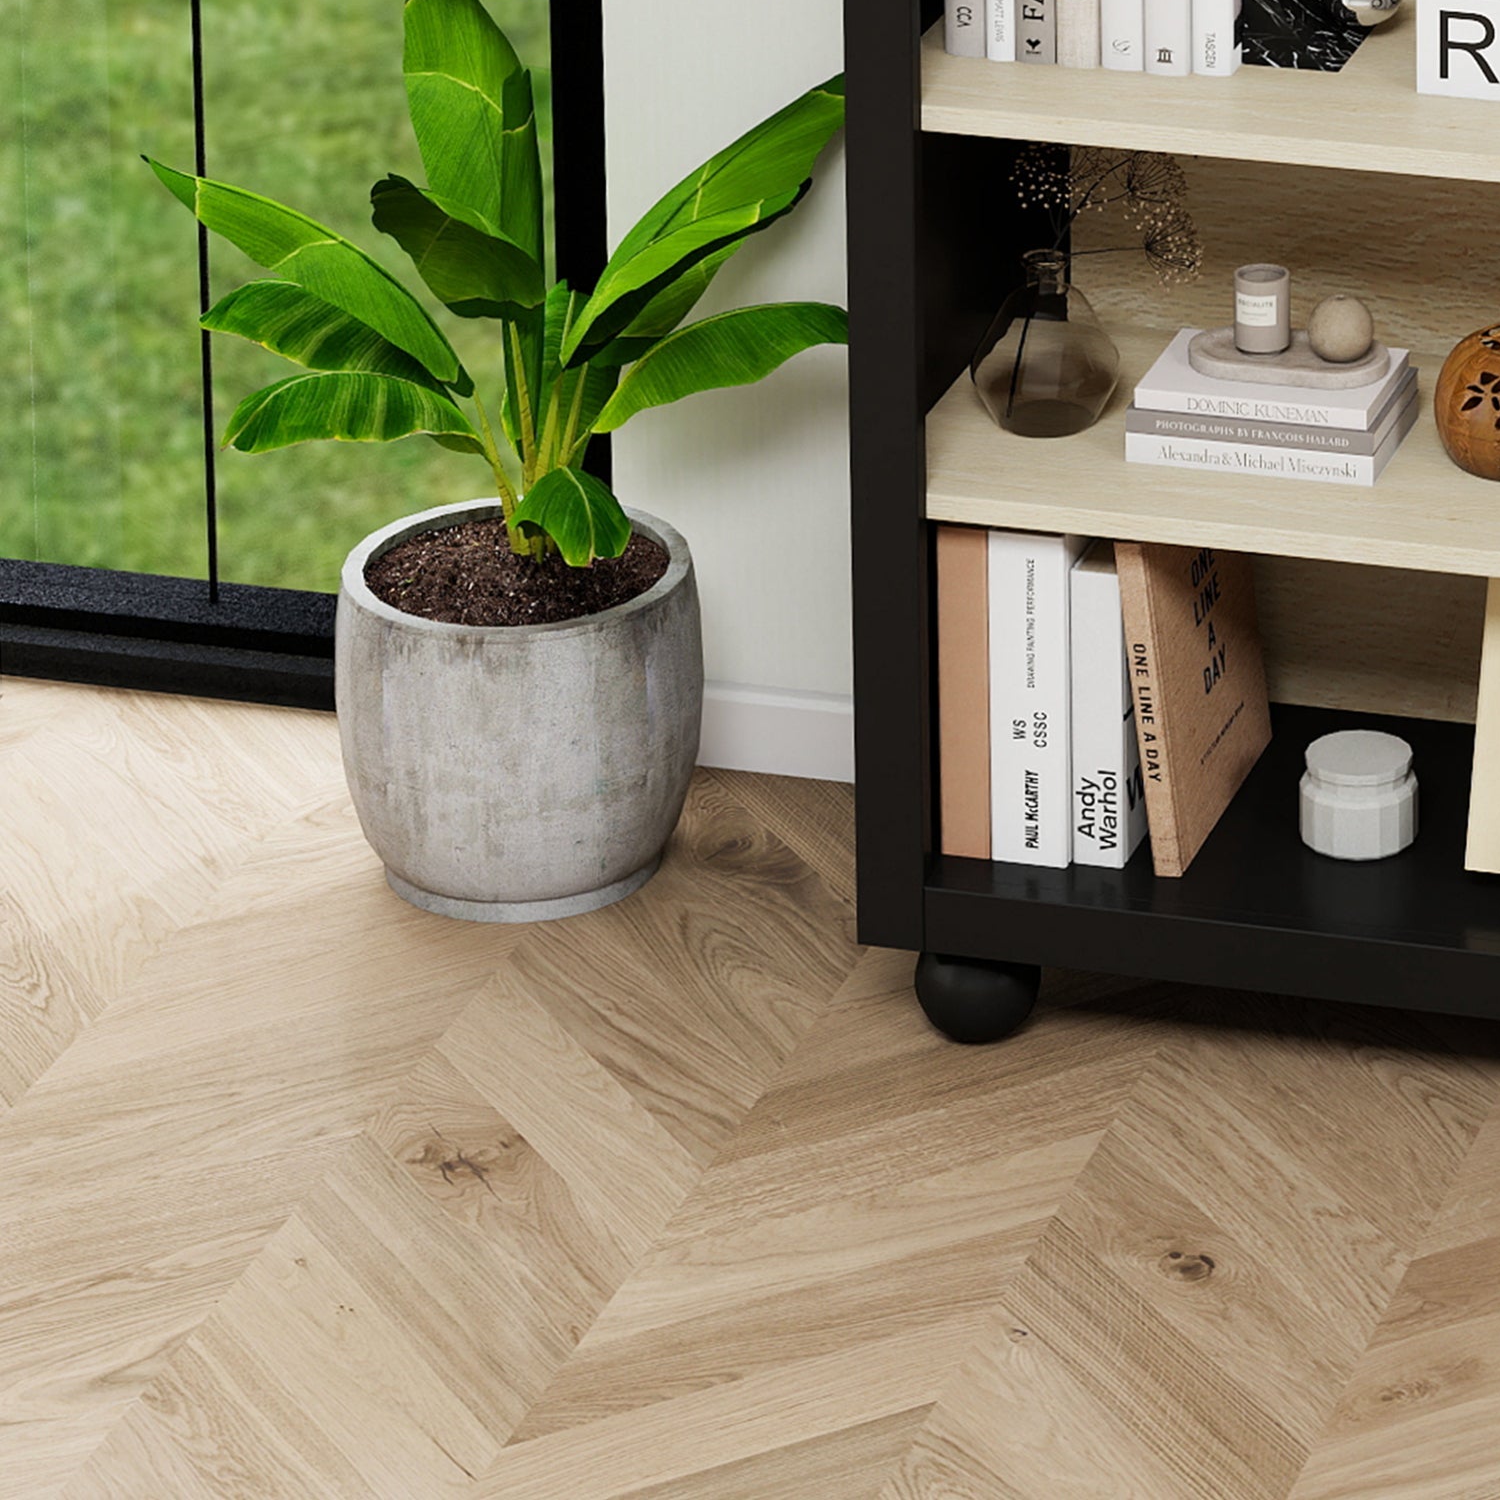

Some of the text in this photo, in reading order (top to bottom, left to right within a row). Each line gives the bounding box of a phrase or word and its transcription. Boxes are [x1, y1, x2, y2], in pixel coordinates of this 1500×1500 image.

[1187, 397, 1329, 424] DOMINIC KUNEMAN
[1155, 419, 1350, 448] PHOTOGRAPHS BY FRANÇOIS HALARD
[1158, 445, 1221, 466] Alexandra
[1235, 451, 1284, 472] Michael
[1191, 548, 1215, 588] ONE
[1193, 571, 1221, 627] LINE
[1208, 622, 1217, 651] A
[1204, 644, 1226, 695] DAY
[1012, 718, 1027, 739] WS
[1033, 711, 1047, 748] CSSC
[1133, 643, 1162, 783] ONE LINE A DAY
[1025, 769, 1039, 849] PAUL McCARTHY
[1075, 777, 1100, 839] Andy
[1097, 770, 1117, 851] Warhol
